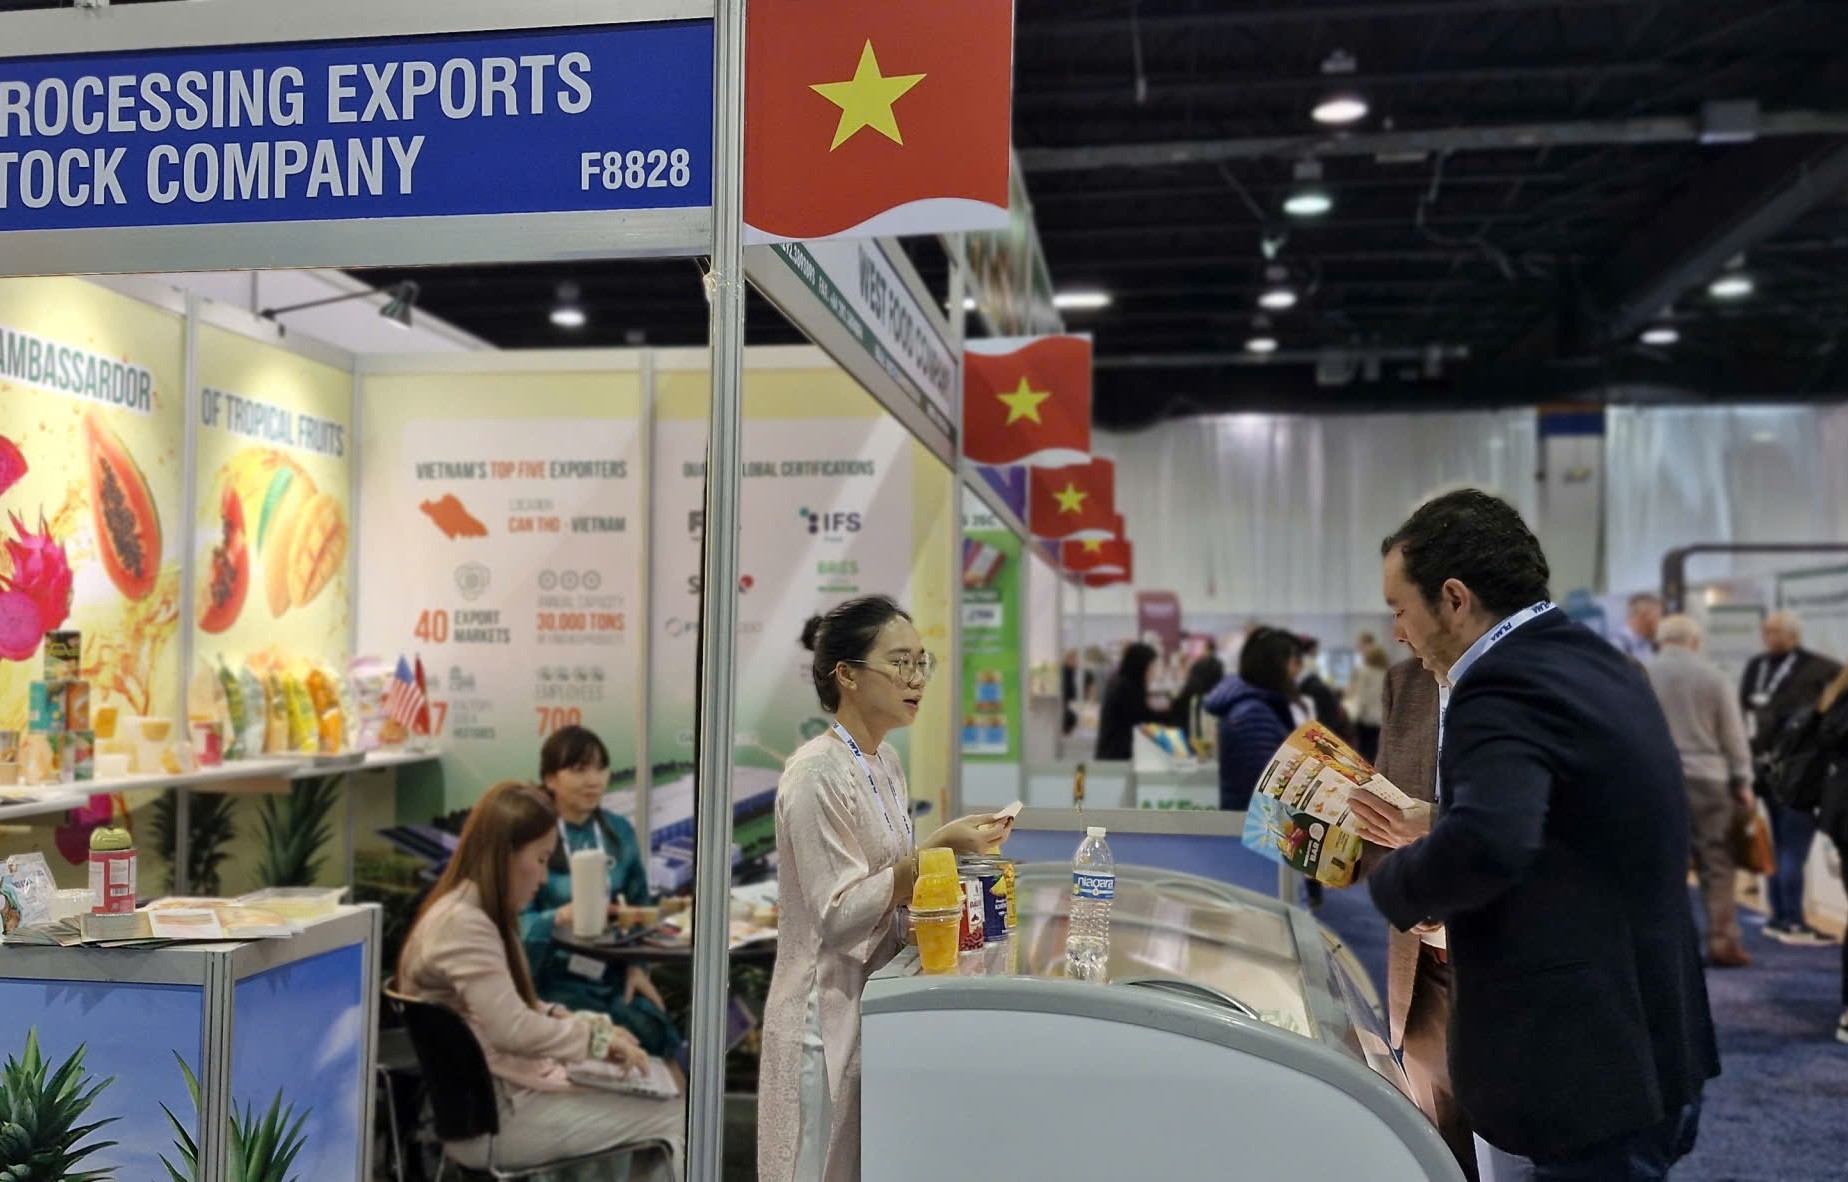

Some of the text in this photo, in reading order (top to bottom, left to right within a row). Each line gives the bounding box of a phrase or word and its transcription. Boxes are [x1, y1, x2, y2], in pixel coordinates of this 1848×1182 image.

[0, 51, 593, 137] ROCESSING EXPORTS
[0, 135, 425, 209] TOCK COMPANY
[580, 148, 690, 190] F8828
[0, 328, 151, 411] AMBASSARDOR
[202, 388, 345, 457] OF TROPICAL FRUITS
[416, 460, 628, 480] VIETNAM'S TOP FIVE EXPORTERS
[781, 460, 875, 477] CERTIFICATIONS
[508, 517, 534, 532] CAN
[537, 517, 561, 532] THO
[571, 517, 626, 532] VIETNAM
[823, 512, 862, 533] IFS
[414, 608, 448, 643] 40
[454, 610, 500, 625] EXPORT
[590, 612, 625, 631] TONS
[453, 628, 511, 643] MARKETS
[535, 705, 581, 736] 700
[1077, 876, 1114, 893] niagara
